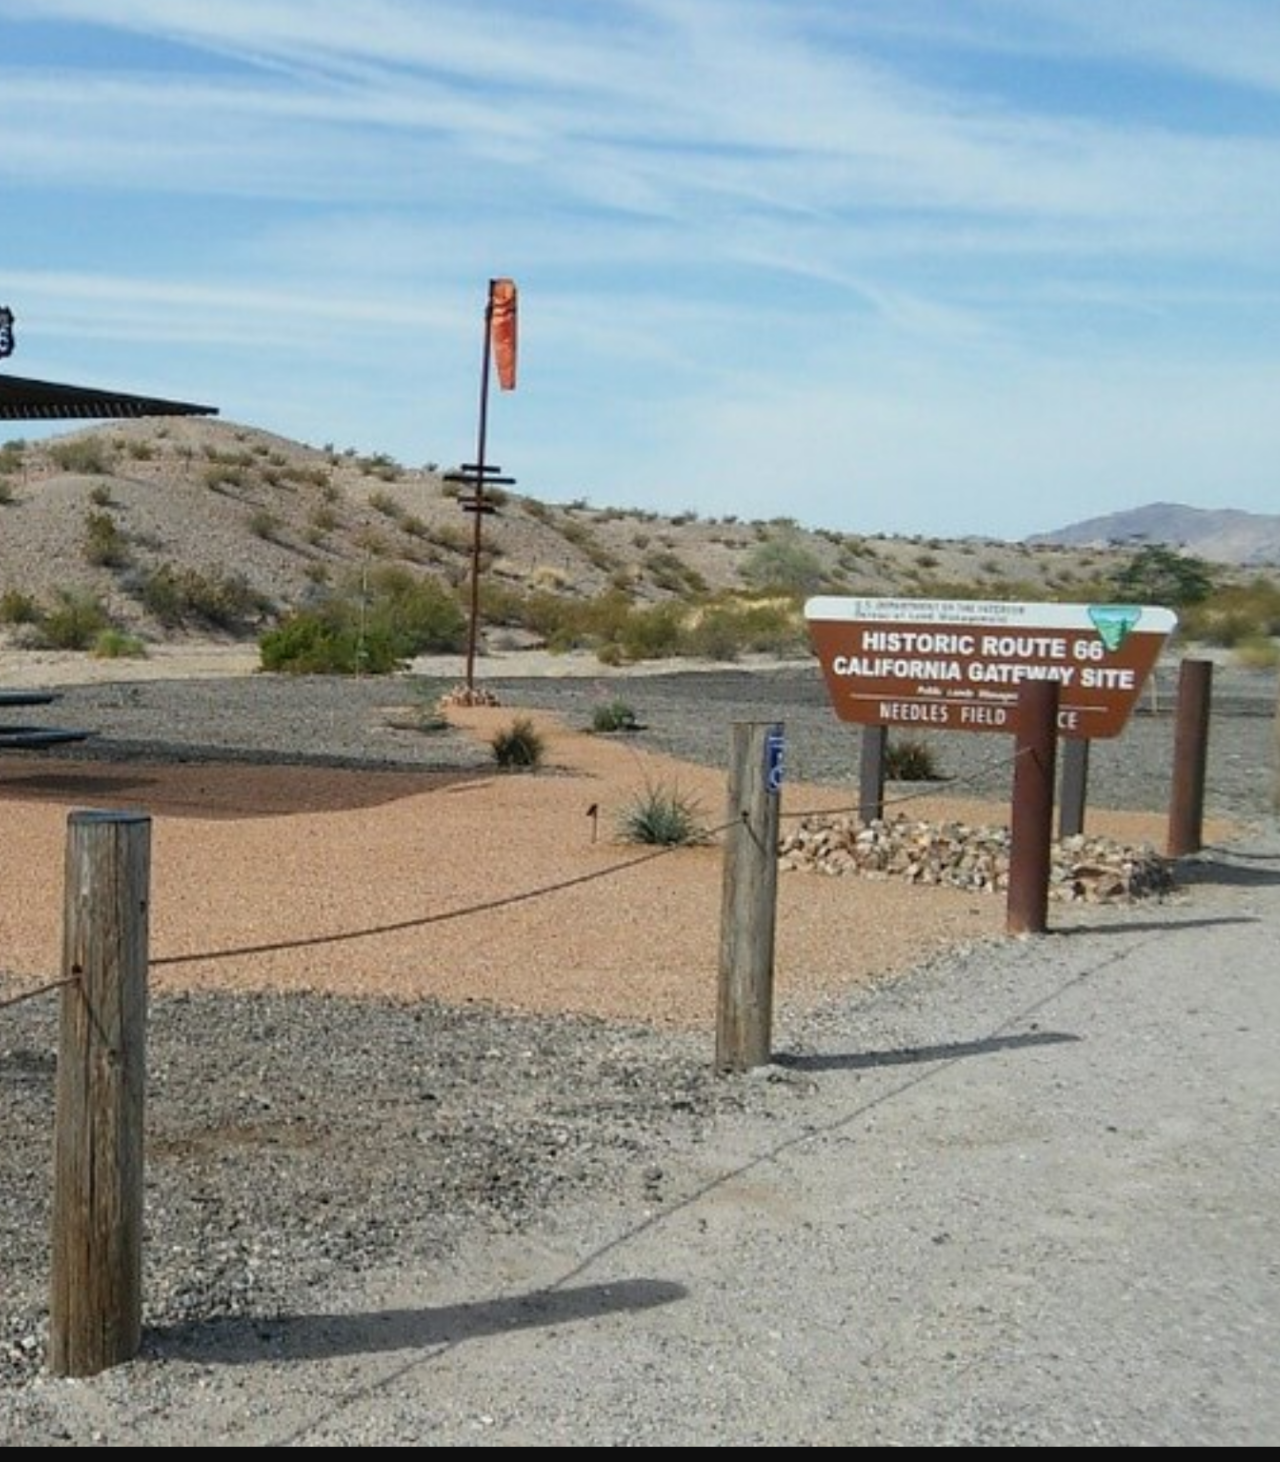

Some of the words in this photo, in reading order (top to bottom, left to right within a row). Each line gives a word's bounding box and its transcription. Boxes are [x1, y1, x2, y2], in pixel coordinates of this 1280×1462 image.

[861, 630, 975, 655] HISTORIC
[981, 635, 1067, 658] ROUTE
[1073, 640, 1104, 661] 66
[832, 655, 962, 681] CALIFORNIA
[968, 662, 1074, 686] GATEWAY
[1080, 668, 1135, 690] SITE
[879, 701, 949, 722] NEEDLES
[960, 706, 1007, 725] FIELD
